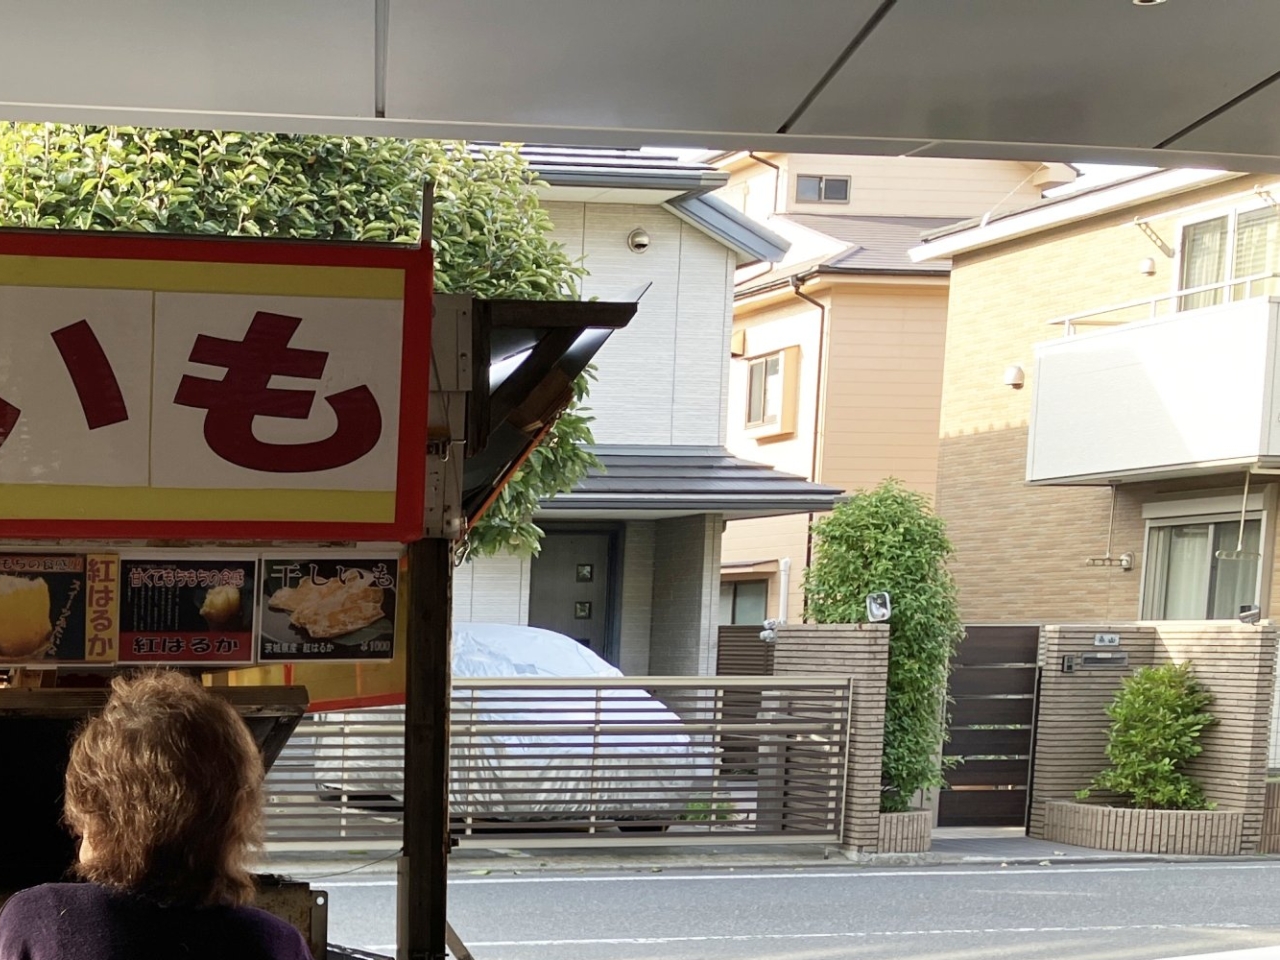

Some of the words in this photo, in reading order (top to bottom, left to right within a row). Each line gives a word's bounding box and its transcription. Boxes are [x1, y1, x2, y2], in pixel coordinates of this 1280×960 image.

[130, 568, 245, 588] 甘くてもちもちの食感
[271, 563, 394, 588] 干しいも
[87, 558, 115, 657] 紅はるか
[133, 637, 239, 655] 紅はるか
[264, 643, 298, 653] 茨城県産
[302, 643, 335, 653] 紅はるか
